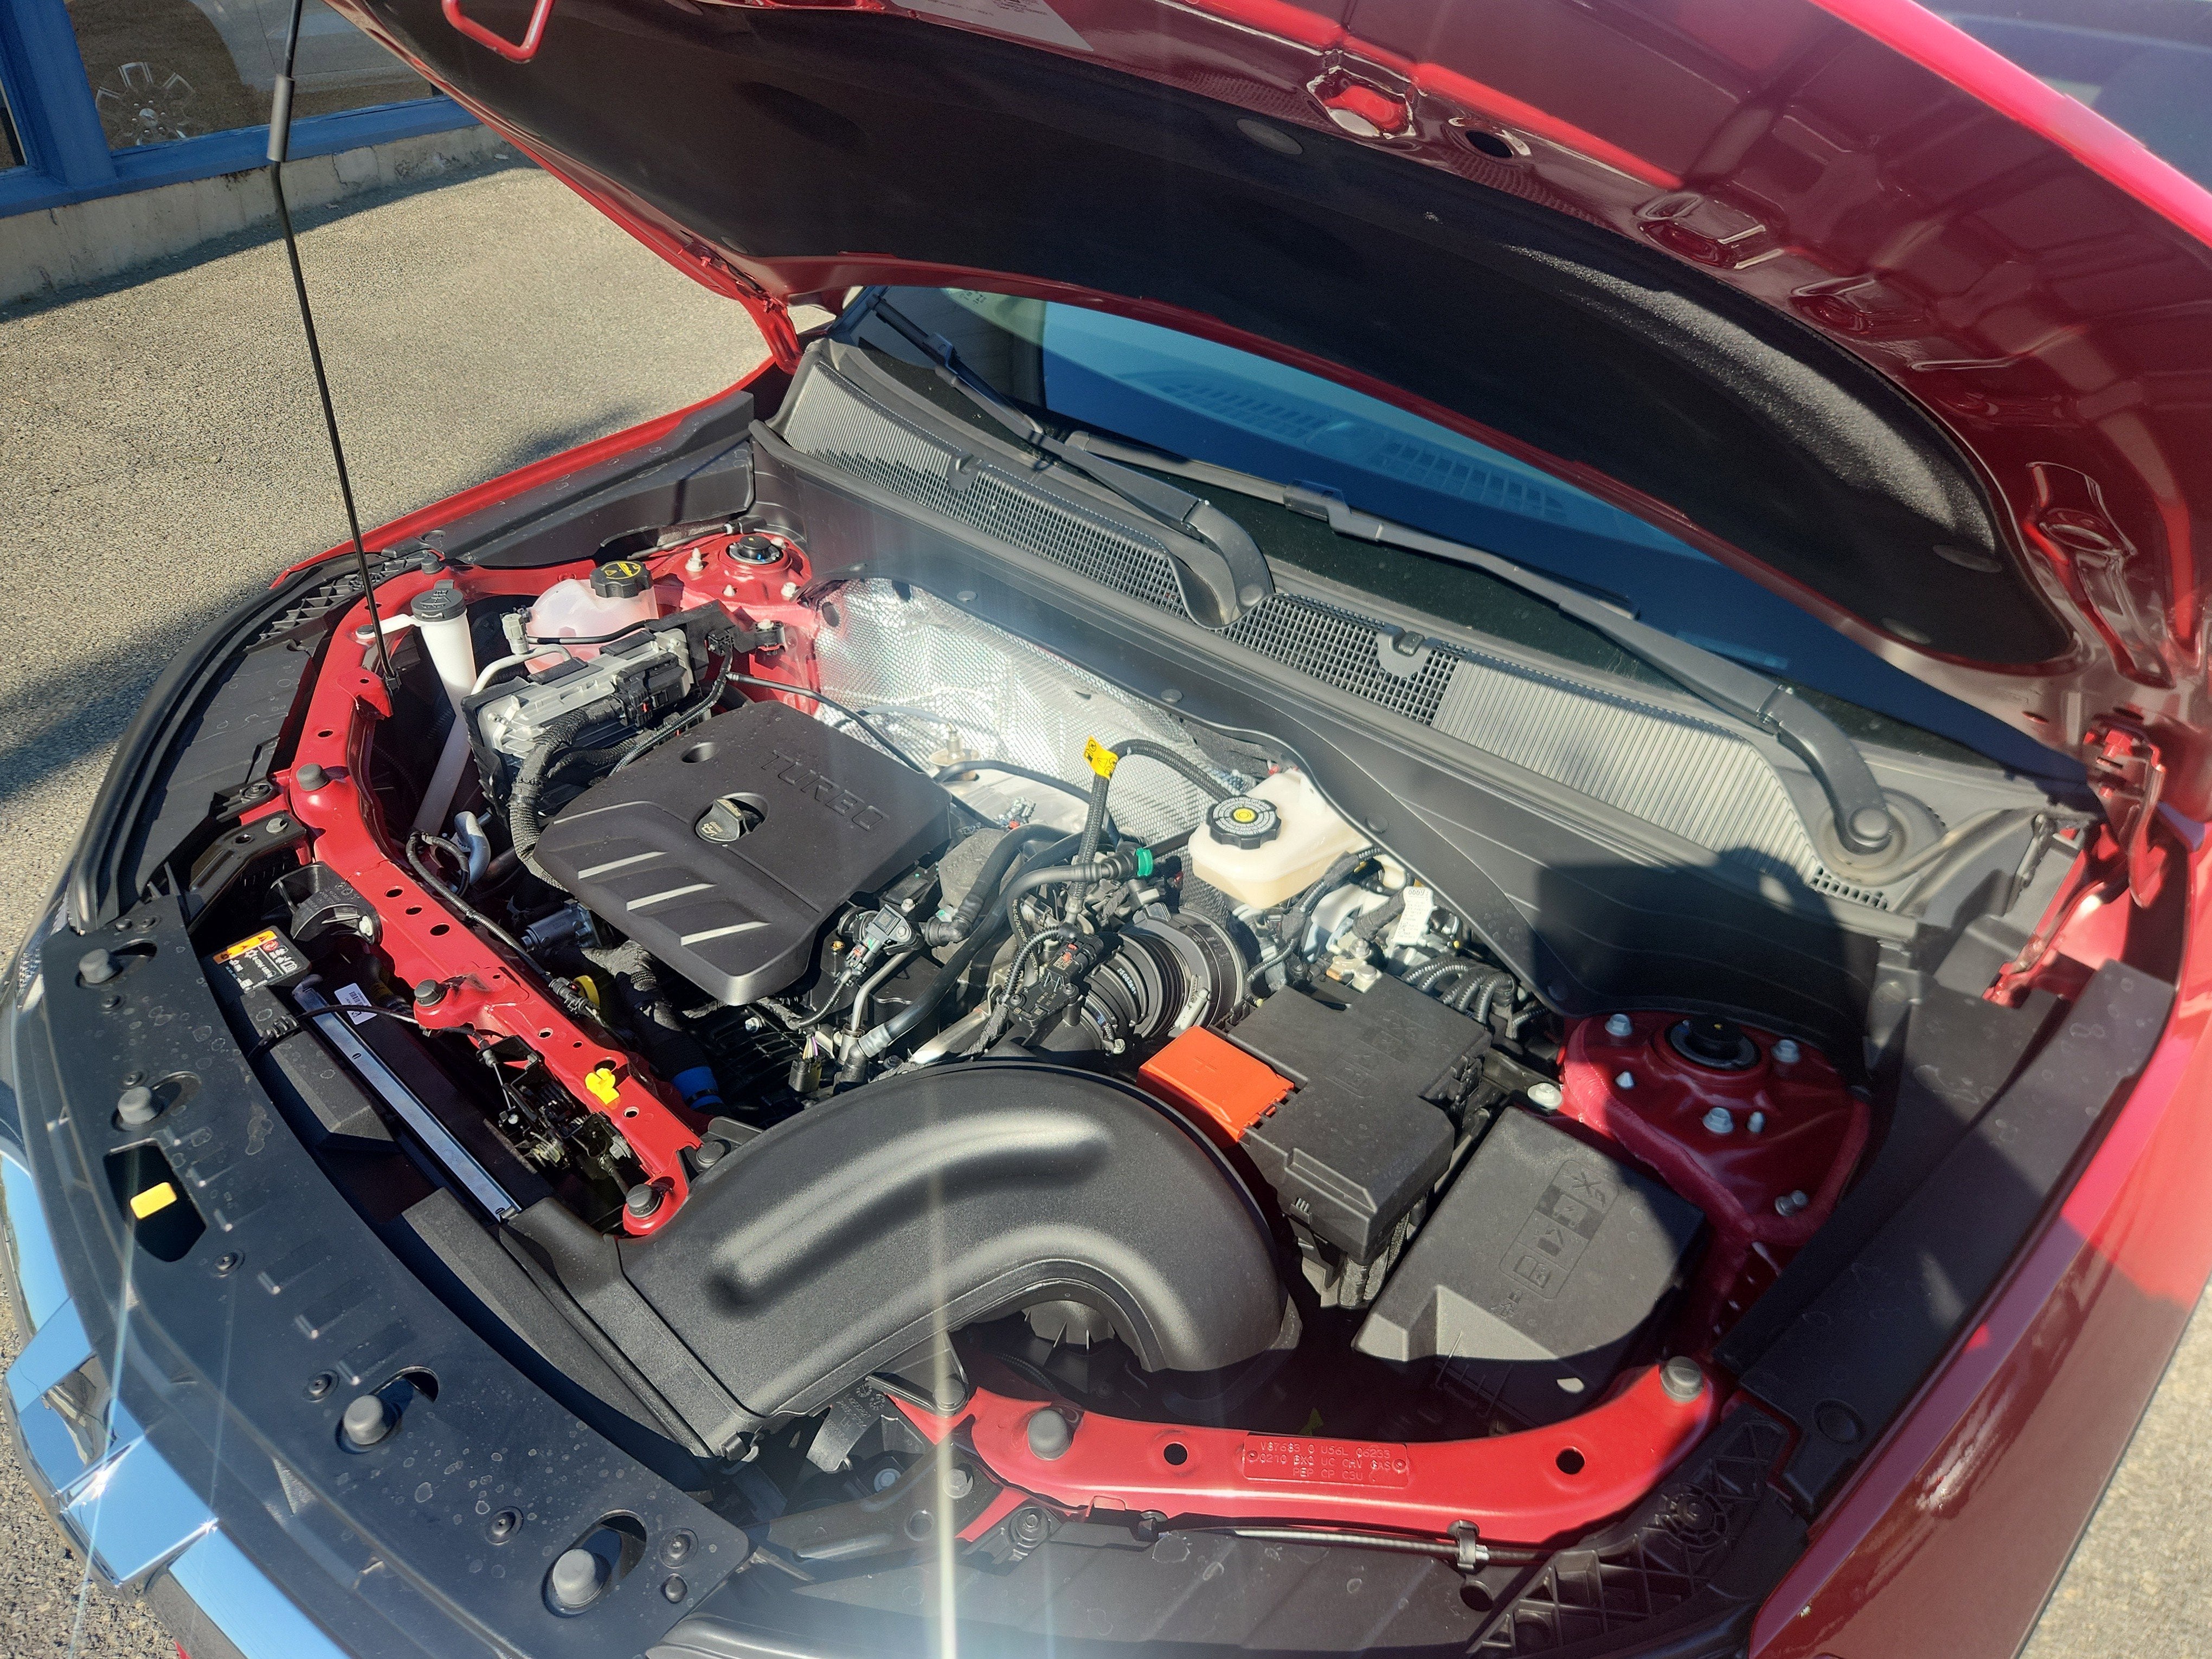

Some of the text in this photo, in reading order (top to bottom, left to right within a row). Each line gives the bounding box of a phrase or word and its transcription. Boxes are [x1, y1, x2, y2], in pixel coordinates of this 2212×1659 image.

[761, 750, 890, 831] TURBO
[840, 1416, 852, 1429] LH
[1293, 1467, 1314, 1477] PEP
[1321, 1468, 1335, 1478] CP
